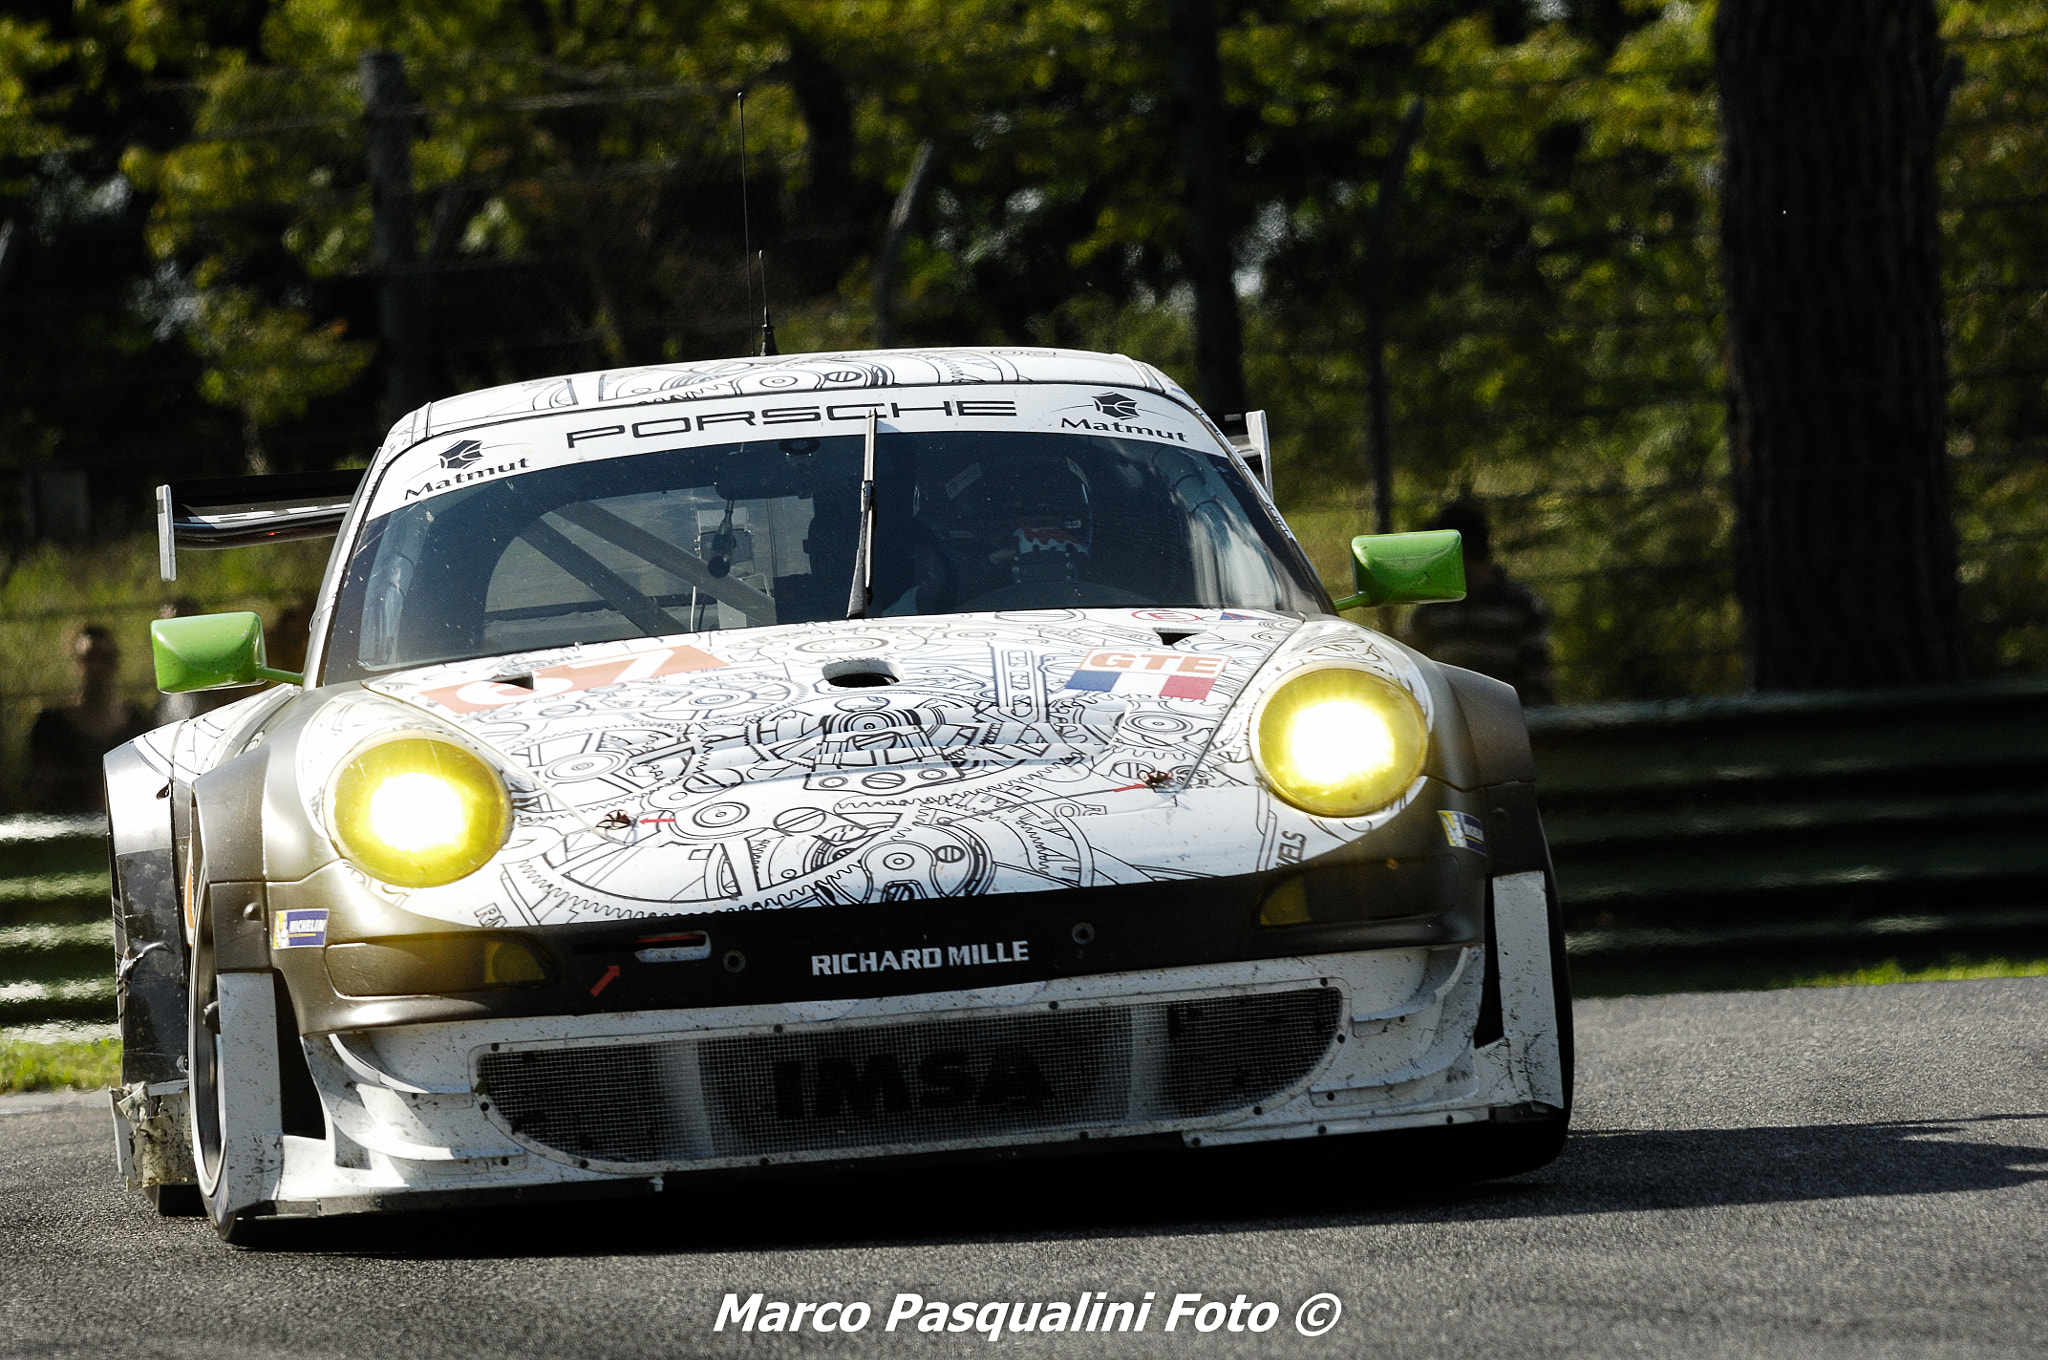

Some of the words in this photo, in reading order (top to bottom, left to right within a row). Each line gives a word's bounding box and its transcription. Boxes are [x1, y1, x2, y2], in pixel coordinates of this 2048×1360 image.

[566, 400, 1018, 448] PORSCHE
[1061, 417, 1188, 442] Matmut
[404, 457, 531, 501] Matmut
[1088, 652, 1223, 675] GTE
[811, 947, 943, 976] RICHARD
[947, 940, 1030, 967] MILLE
[775, 1045, 1054, 1121] IMSA
